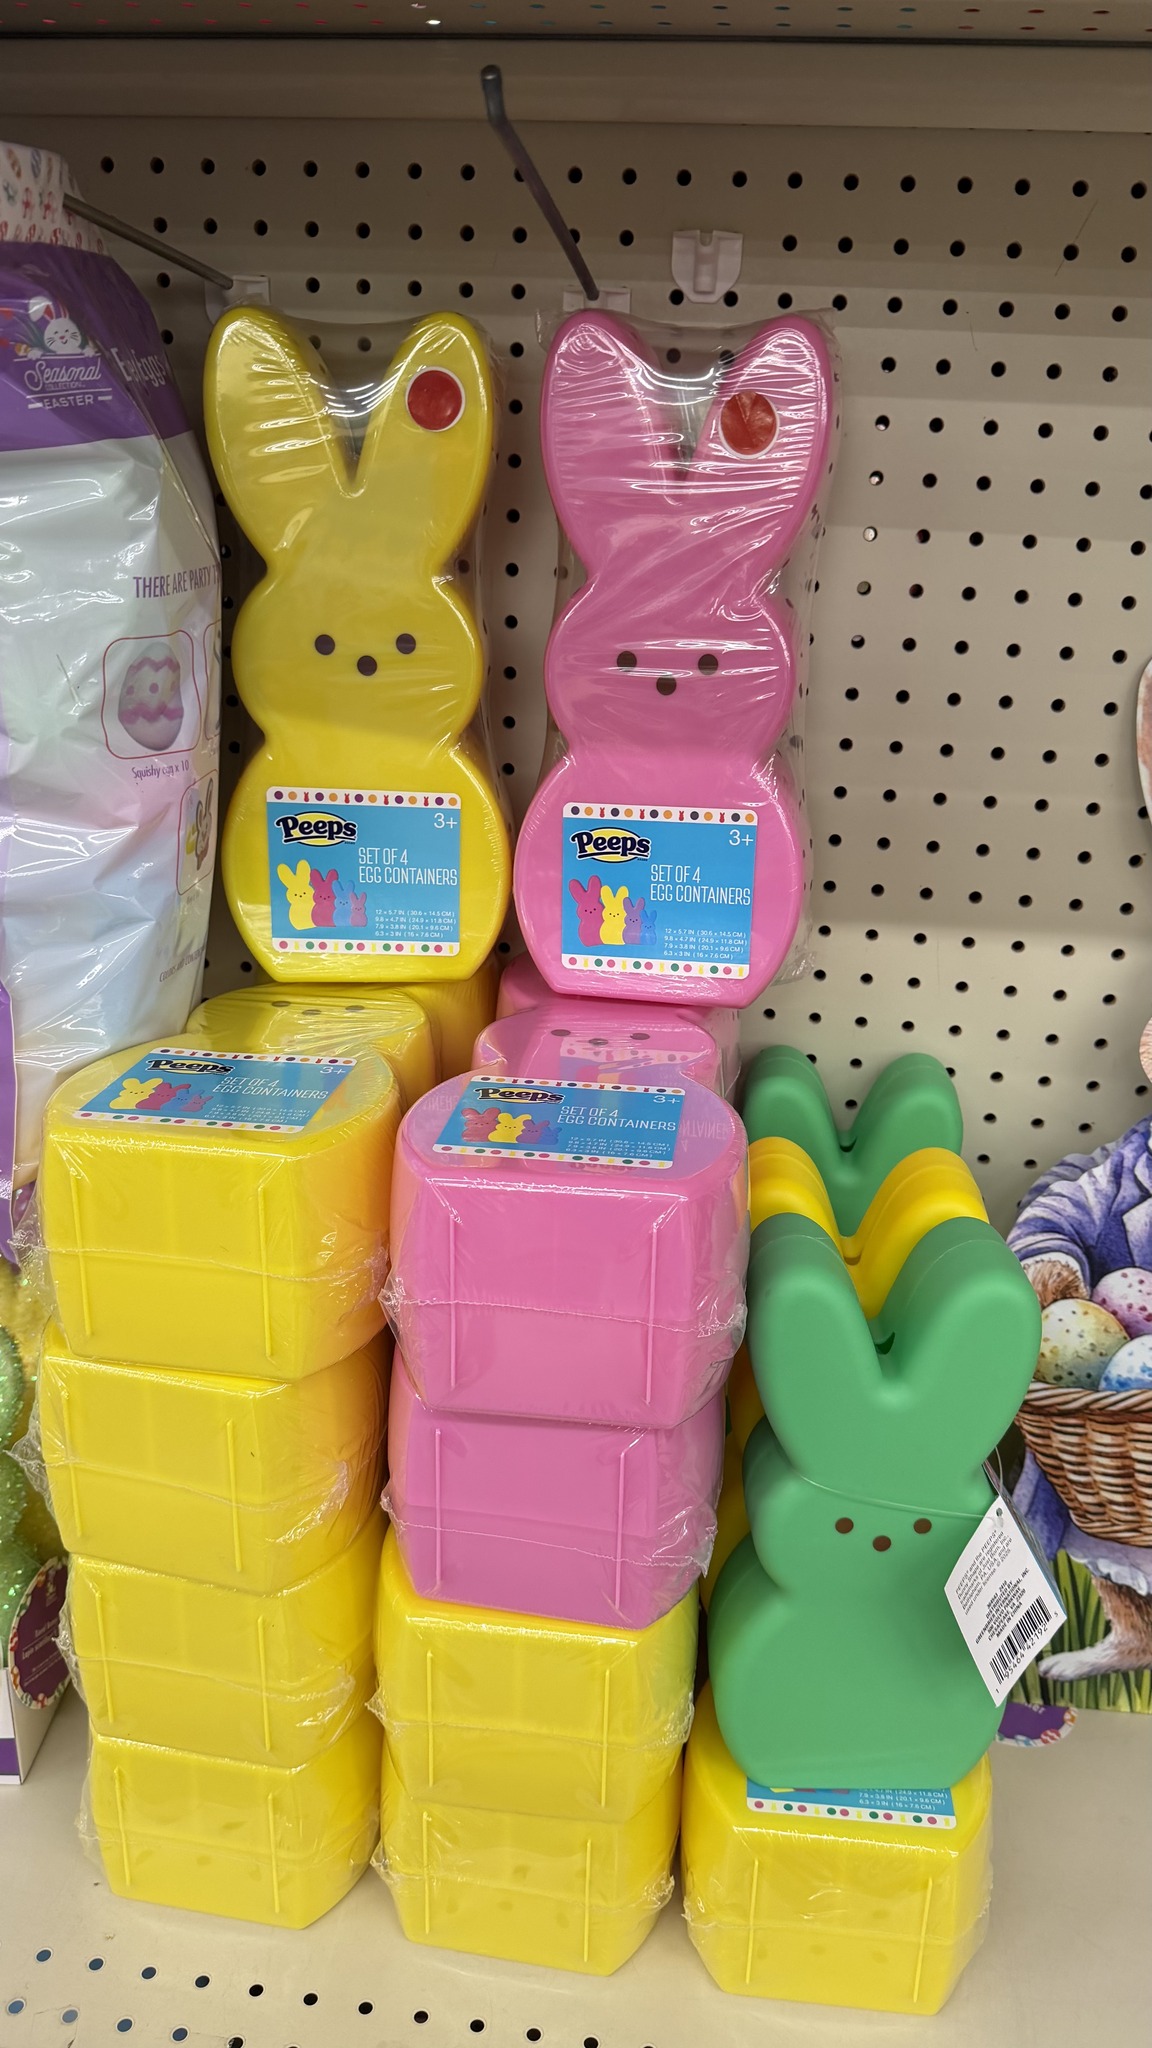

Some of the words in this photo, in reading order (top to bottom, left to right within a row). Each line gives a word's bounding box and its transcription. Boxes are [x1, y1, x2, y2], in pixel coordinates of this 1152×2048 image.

[24, 357, 102, 392] Seasonal
[42, 394, 94, 410] EASTER
[133, 575, 170, 598] THERE
[172, 571, 188, 594] ARE
[189, 566, 211, 591] PARTY
[131, 762, 162, 780] Squishy
[174, 764, 181, 773] x
[181, 759, 190, 773] 10
[275, 815, 357, 841] Peeps
[433, 813, 458, 829] 3+
[570, 831, 651, 856] Peeps
[728, 829, 754, 847] 3+
[358, 847, 380, 865] SET
[382, 848, 398, 865] OF
[399, 849, 409, 866] 4
[359, 867, 382, 883] EGG
[384, 867, 458, 886] CONTAINERS
[650, 864, 673, 883] SET
[675, 865, 690, 883] OF
[692, 866, 701, 884] 4
[650, 883, 673, 901] EGG
[675, 884, 751, 906] CONTAINERS
[147, 1059, 234, 1075] Peeps
[319, 1066, 347, 1076] 3+
[220, 1076, 248, 1087] SET
[249, 1078, 267, 1087] OF
[267, 1078, 280, 1088] 4
[212, 1084, 241, 1094] EGG
[241, 1086, 329, 1100] CONTAINERS
[475, 1087, 565, 1104] Peeps
[653, 1094, 681, 1105] 3+
[560, 1105, 587, 1116] SET
[588, 1107, 609, 1117] OF
[609, 1108, 620, 1118] 4
[557, 1114, 585, 1125] EGG
[585, 1115, 677, 1132] CONTAINERS
[998, 1545, 1006, 1557] and
[978, 1568, 983, 1576] of
[973, 1585, 983, 1602] under
[985, 1587, 1008, 1619] DISTRIBUTED
[1007, 1581, 1013, 1589] BY
[993, 1609, 1005, 1625] VOLVO
[1003, 1587, 1021, 1611] PARKWAY
[1010, 1602, 1016, 1610] VA
[996, 1622, 1007, 1638] MADE
[1006, 1616, 1012, 1624] IN
[1010, 1601, 1023, 1618] CHINA
[1003, 1649, 1026, 1681] 95464
[1024, 1620, 1048, 1653] 42192
